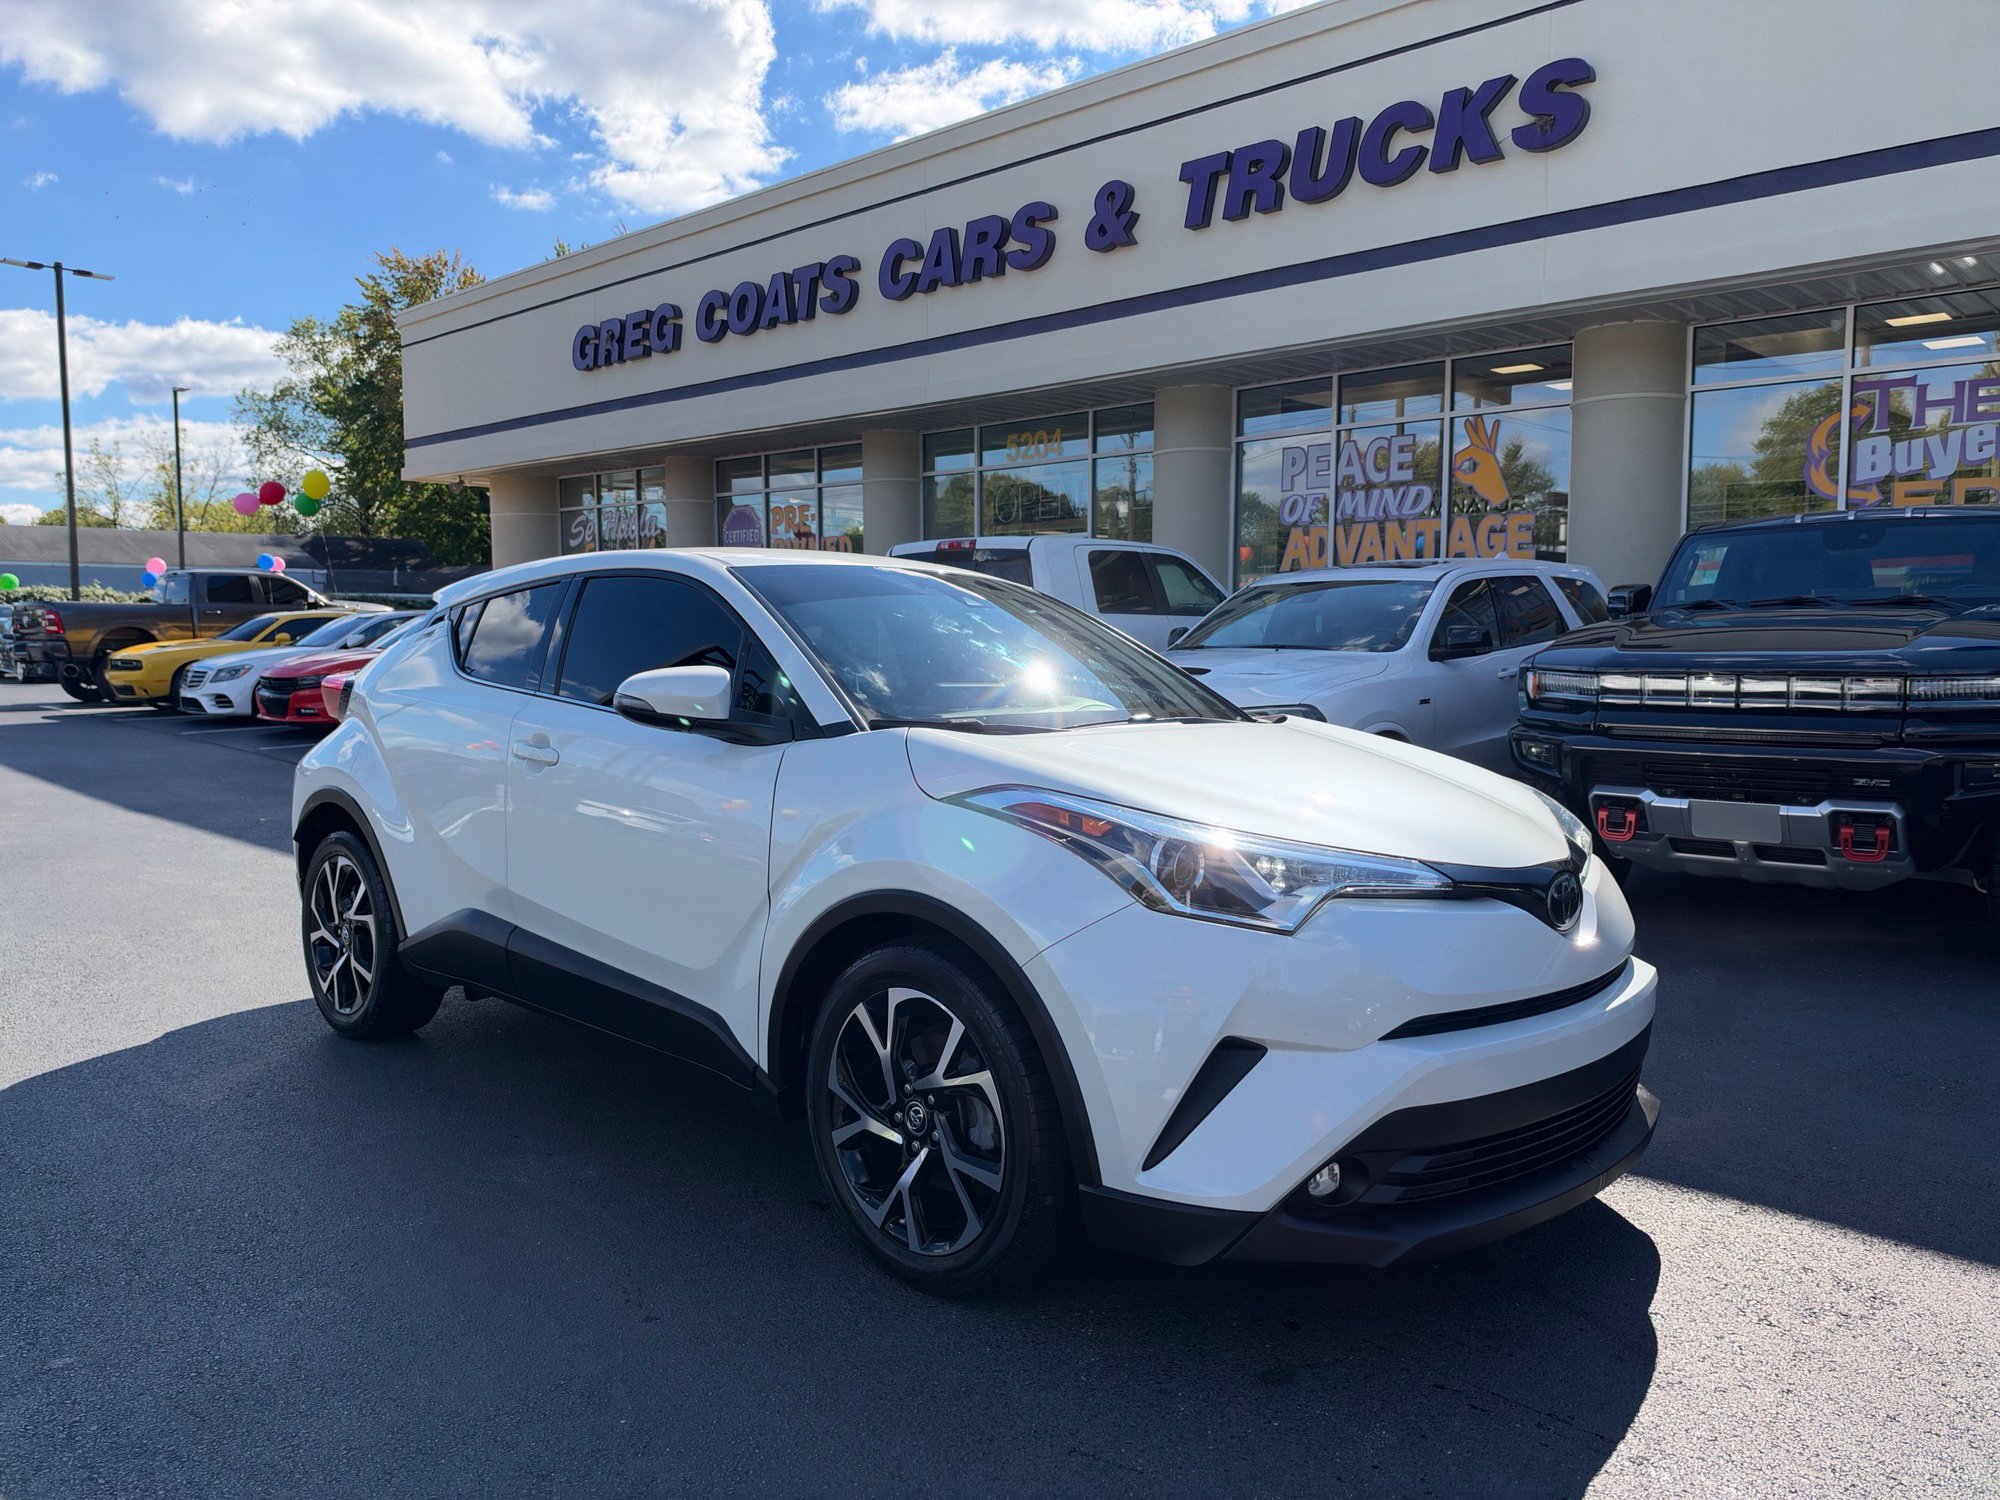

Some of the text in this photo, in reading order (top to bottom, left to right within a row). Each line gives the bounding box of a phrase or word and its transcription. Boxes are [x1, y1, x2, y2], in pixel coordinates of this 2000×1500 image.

[572, 57, 1596, 372] GREG COATS CARS & TRUCKS
[1852, 375, 2000, 433] THE
[1005, 428, 1064, 462] 5204
[1281, 433, 1416, 492] PEACE
[1853, 423, 2000, 484] Buye
[569, 506, 660, 547] Se Habla
[996, 480, 1079, 523] OPEN
[1280, 493, 1325, 526] OF
[1336, 484, 1434, 522] MIND
[725, 528, 760, 544] CERTIFIED
[1278, 512, 1536, 573] ADVANTAGE
